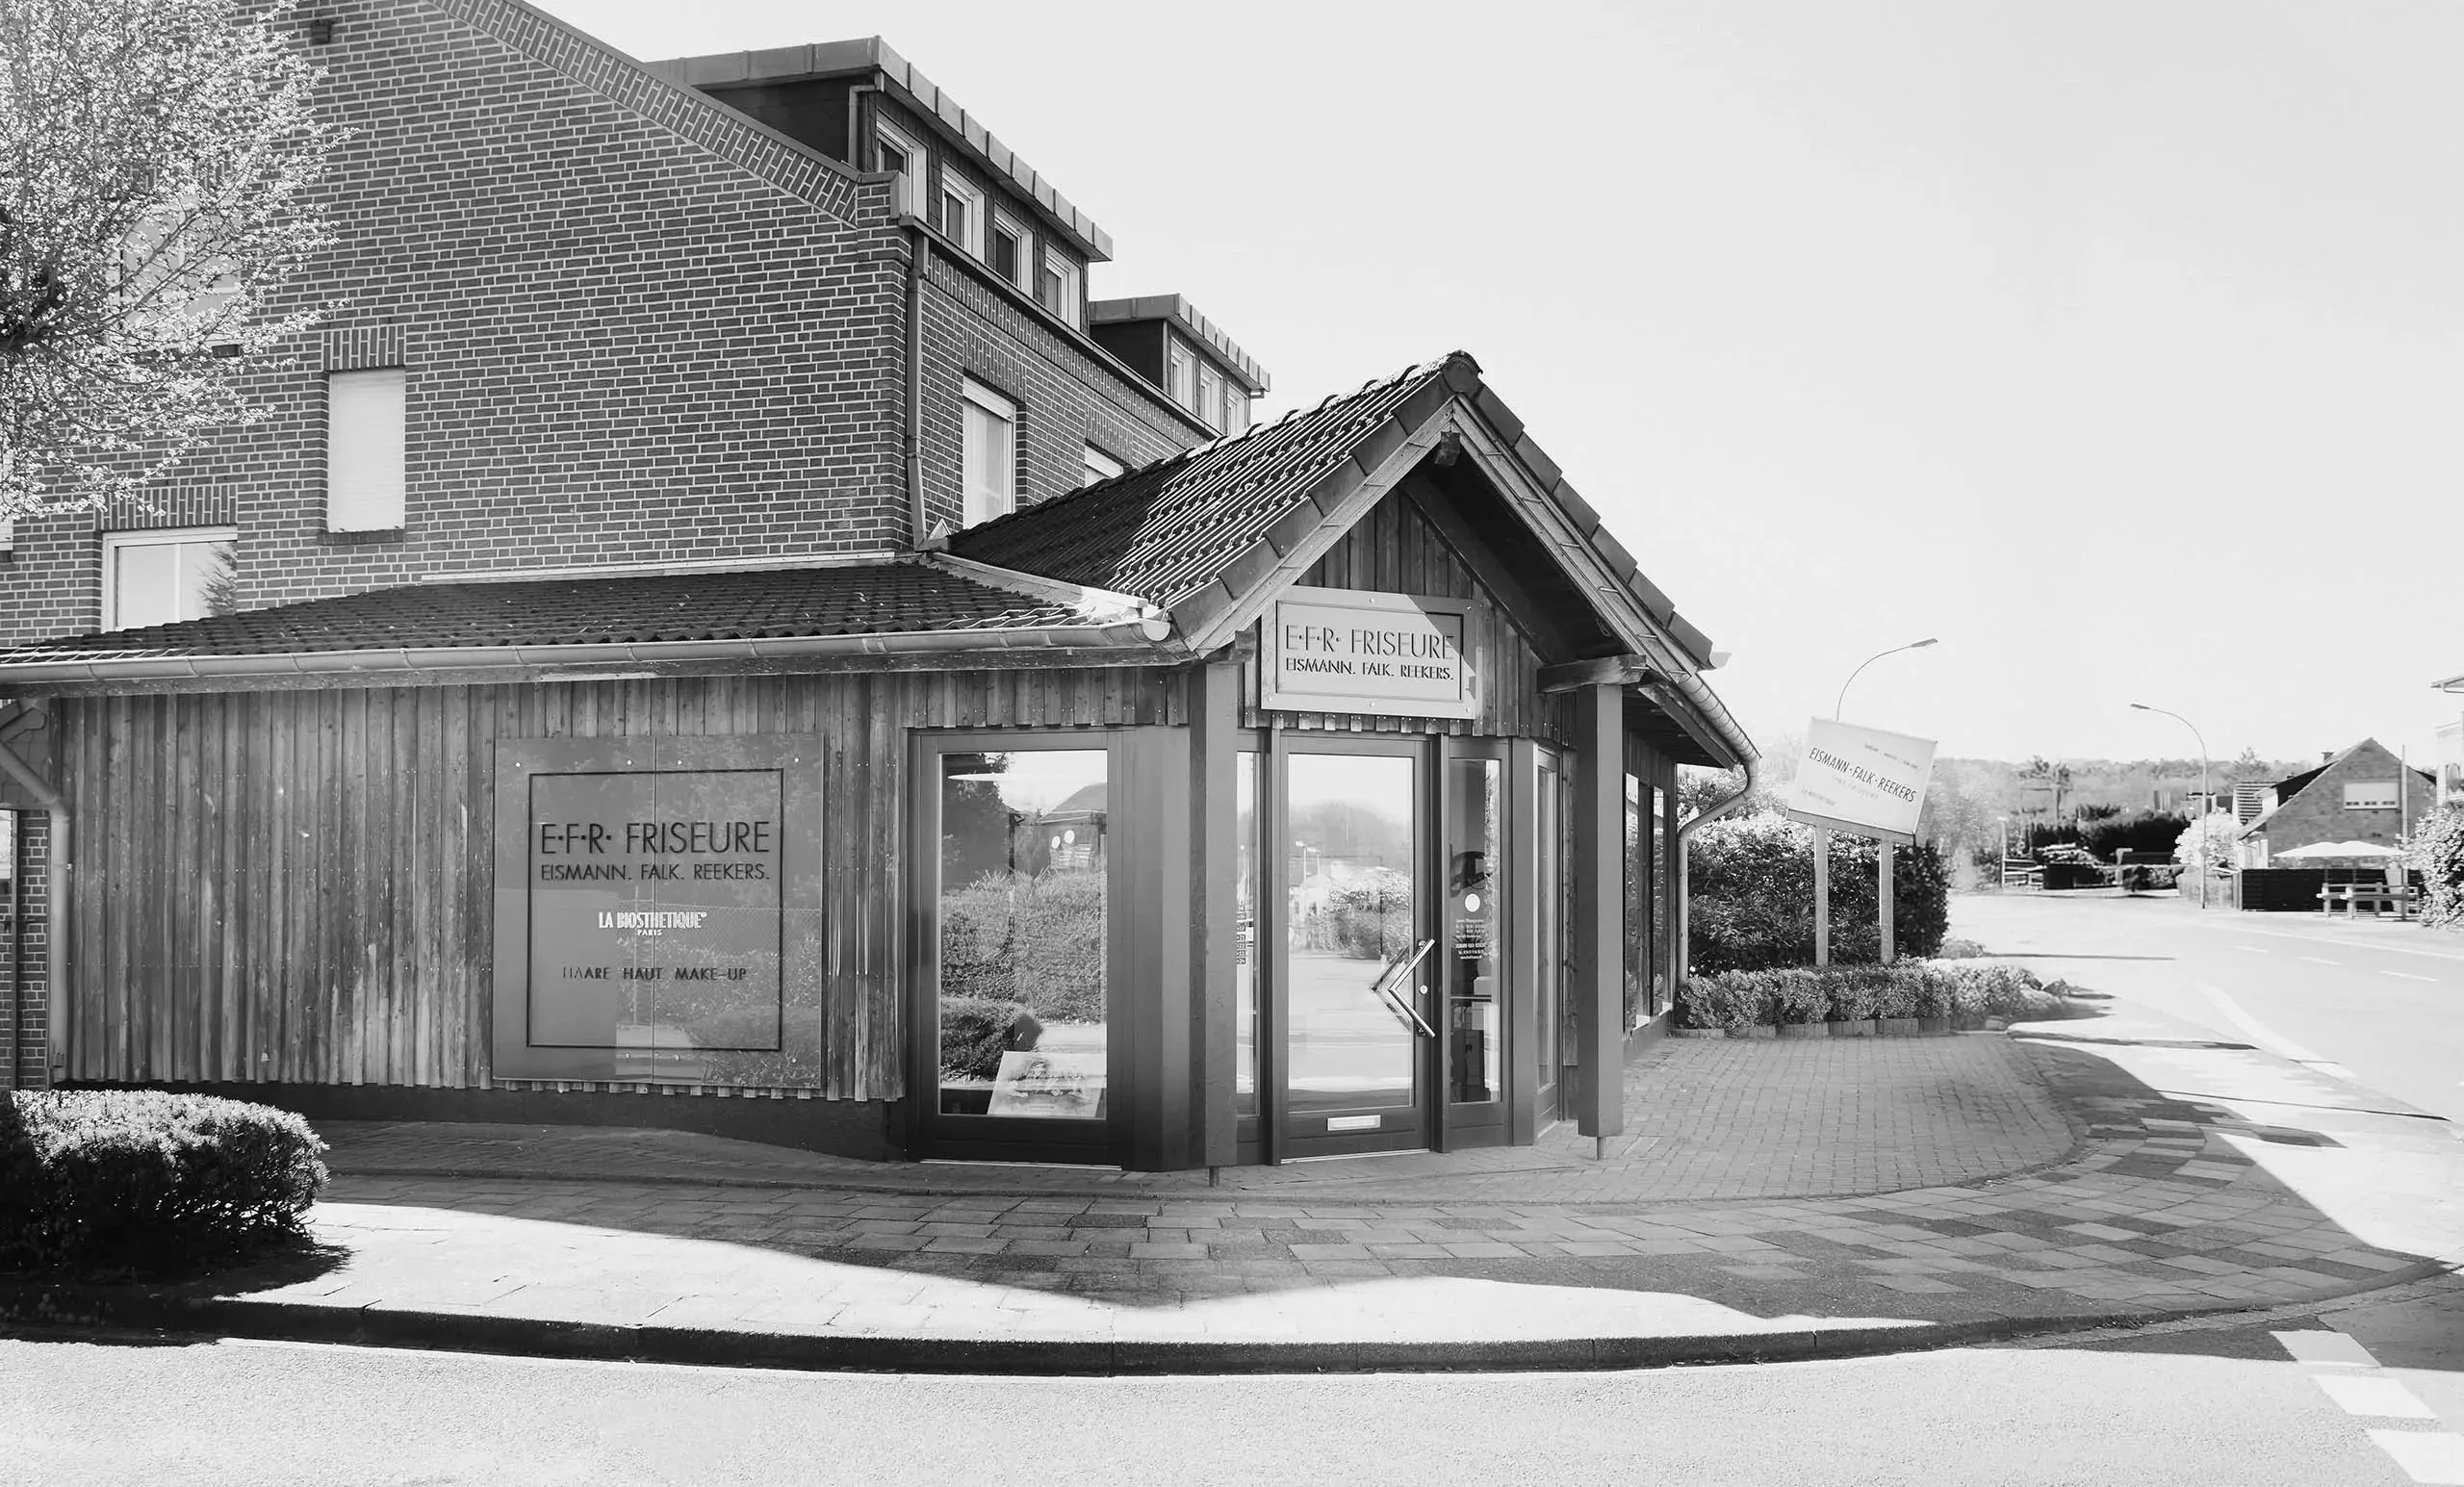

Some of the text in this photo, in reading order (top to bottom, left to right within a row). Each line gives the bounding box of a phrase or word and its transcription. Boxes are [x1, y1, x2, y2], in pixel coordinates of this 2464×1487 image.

[1351, 628, 1455, 660] FRISEURE
[1286, 657, 1454, 680] EISMANN. FALK. REEKERS.
[627, 821, 770, 854] FRISEURE
[541, 862, 770, 881] EISMANN. FALK. REEKERS.
[599, 911, 614, 929] LA
[623, 967, 663, 981] HAUT
[675, 967, 748, 981] MAKE-UP
